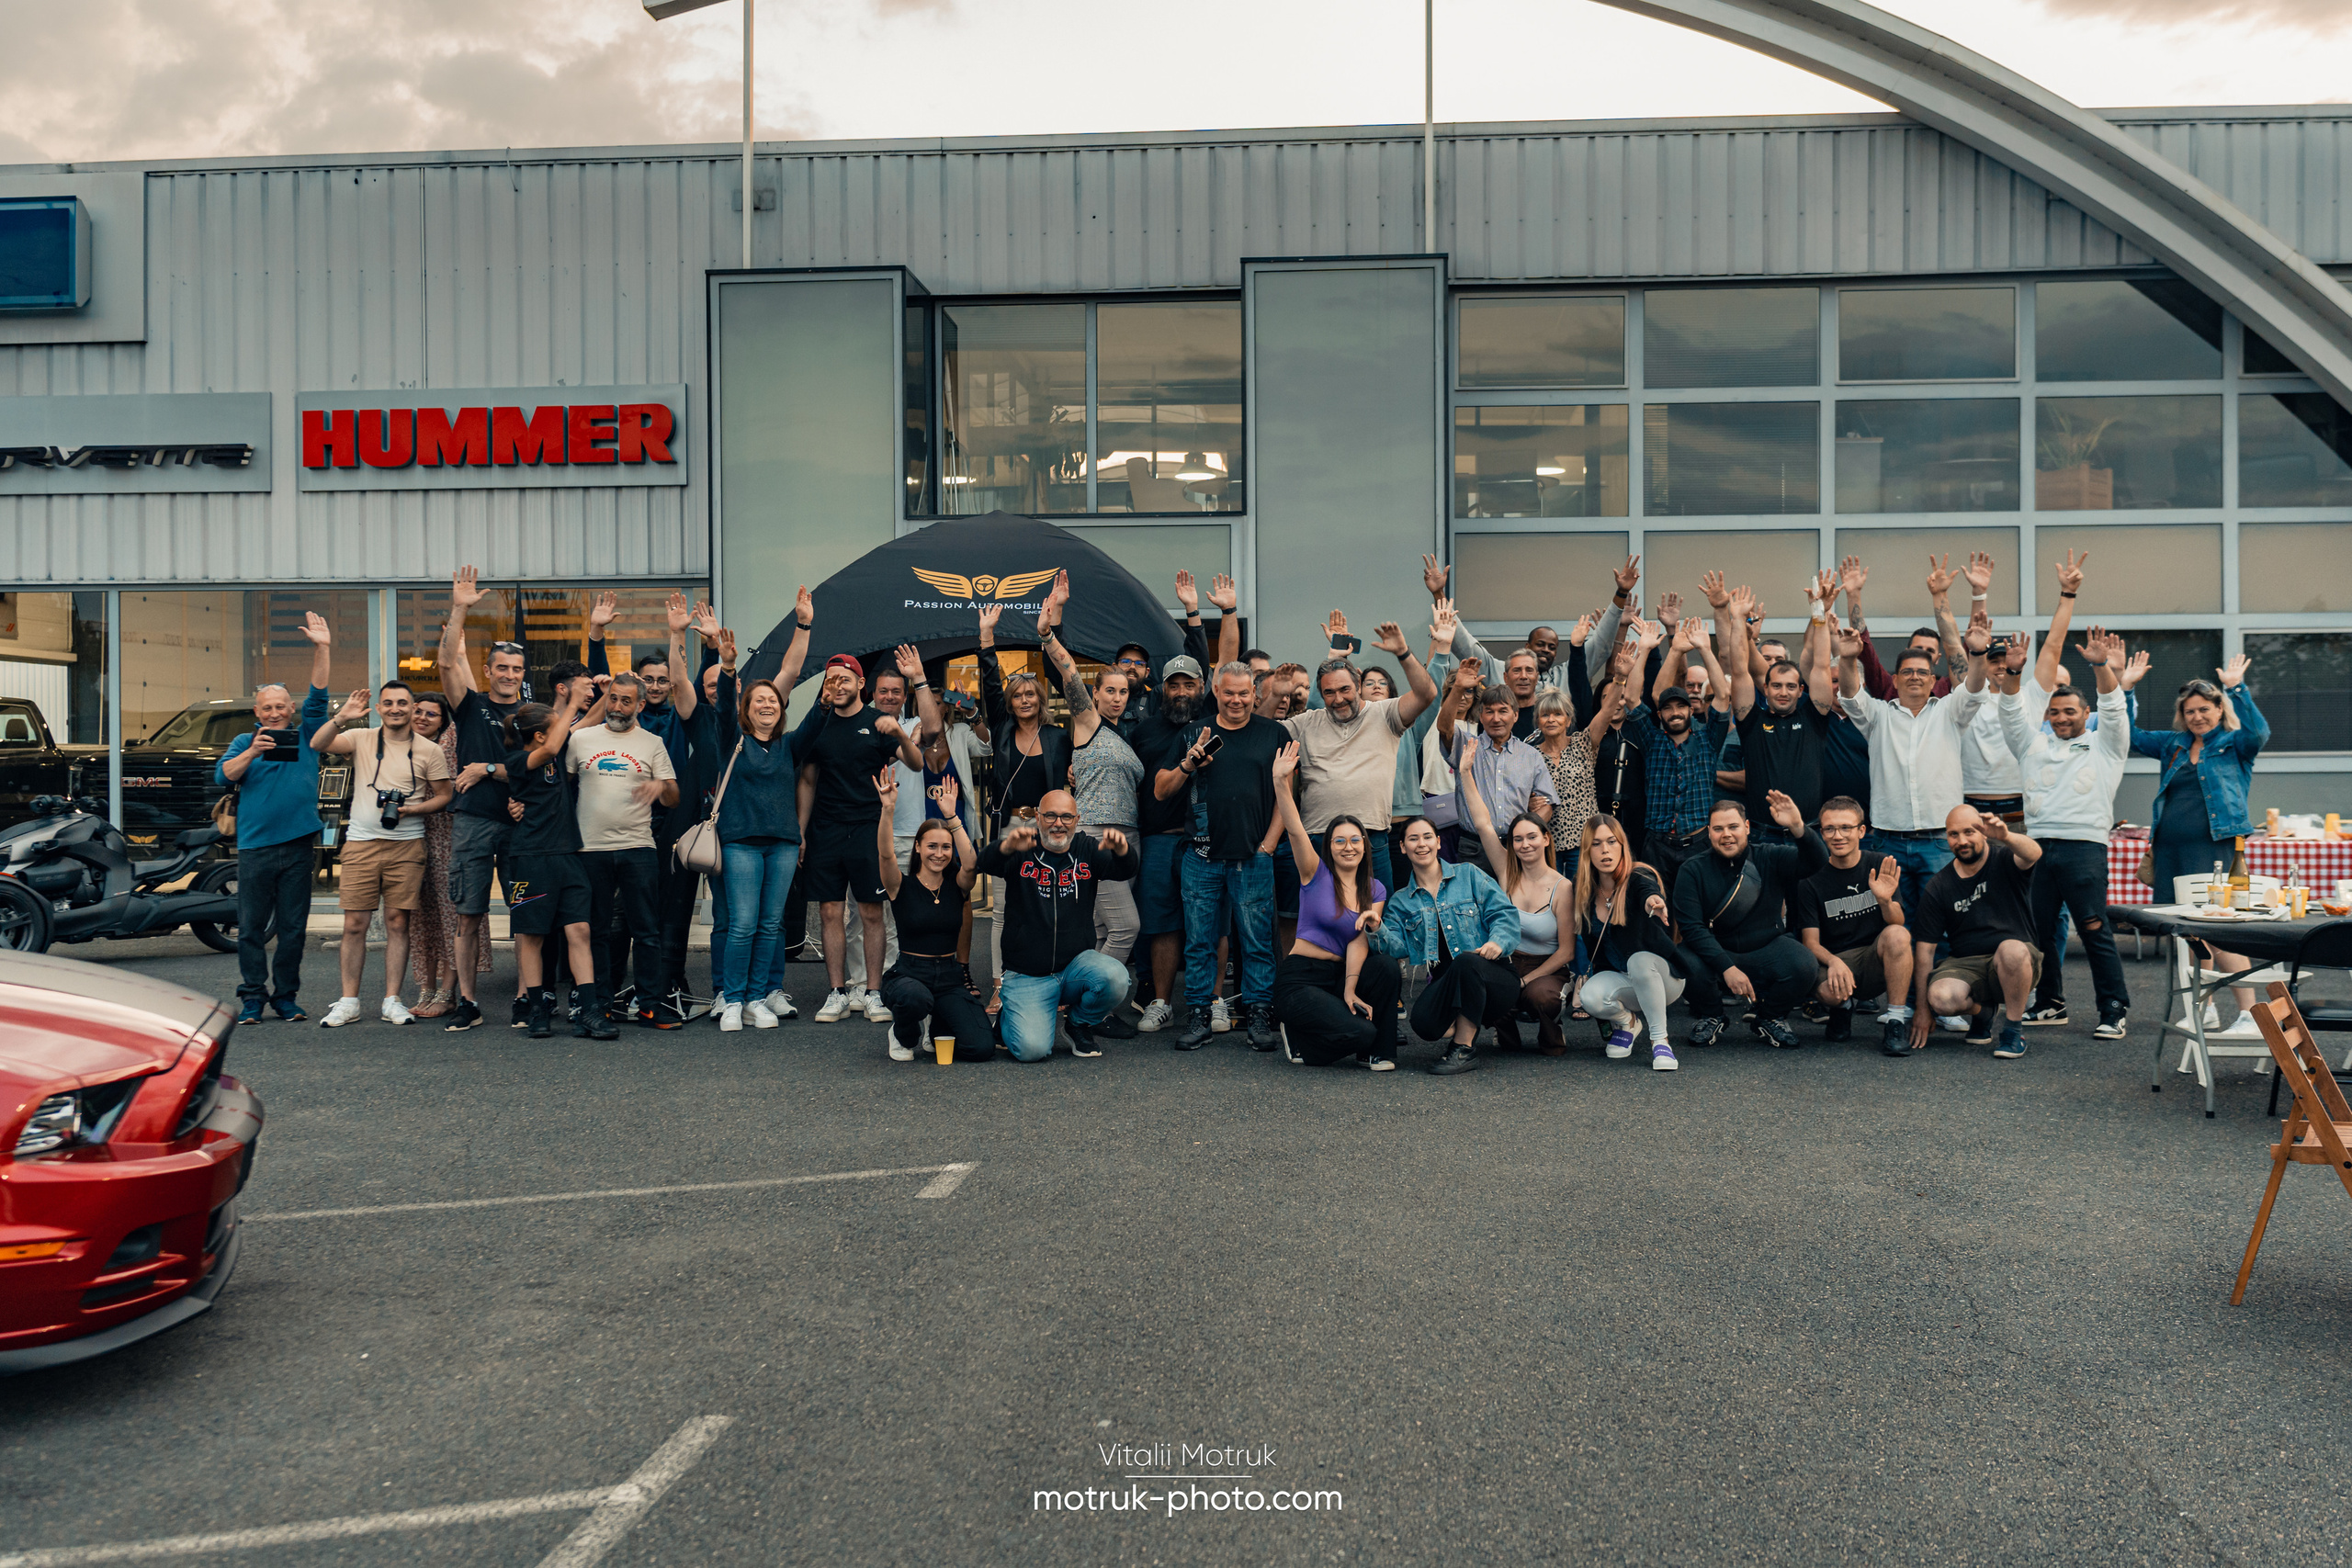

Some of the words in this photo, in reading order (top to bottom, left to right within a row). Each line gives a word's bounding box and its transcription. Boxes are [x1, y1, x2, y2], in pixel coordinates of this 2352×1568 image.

[301, 402, 678, 469] HUMMER
[0, 443, 255, 468] RVETTE
[904, 599, 963, 610] PASSION
[967, 601, 1043, 611] AUTMOBIL
[585, 750, 616, 770] CLASSIQUE
[621, 751, 642, 773] LACOSTE
[121, 776, 173, 788] GMC
